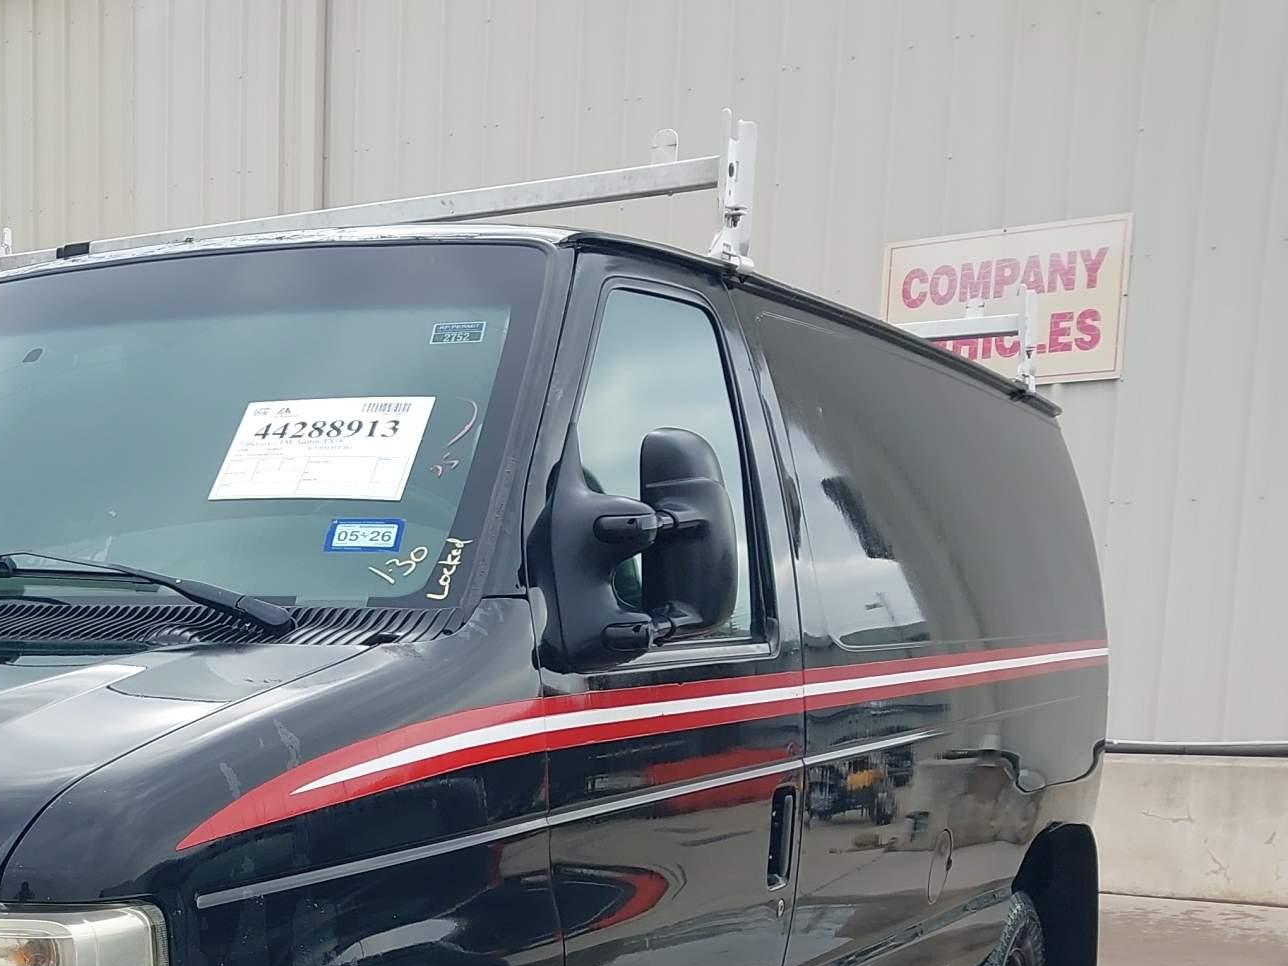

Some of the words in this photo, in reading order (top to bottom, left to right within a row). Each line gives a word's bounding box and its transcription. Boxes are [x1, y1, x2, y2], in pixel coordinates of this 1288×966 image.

[902, 246, 1110, 309] COMPANY
[444, 332, 470, 342] 2752
[254, 419, 400, 440] 44288913
[426, 537, 473, 600] Locked
